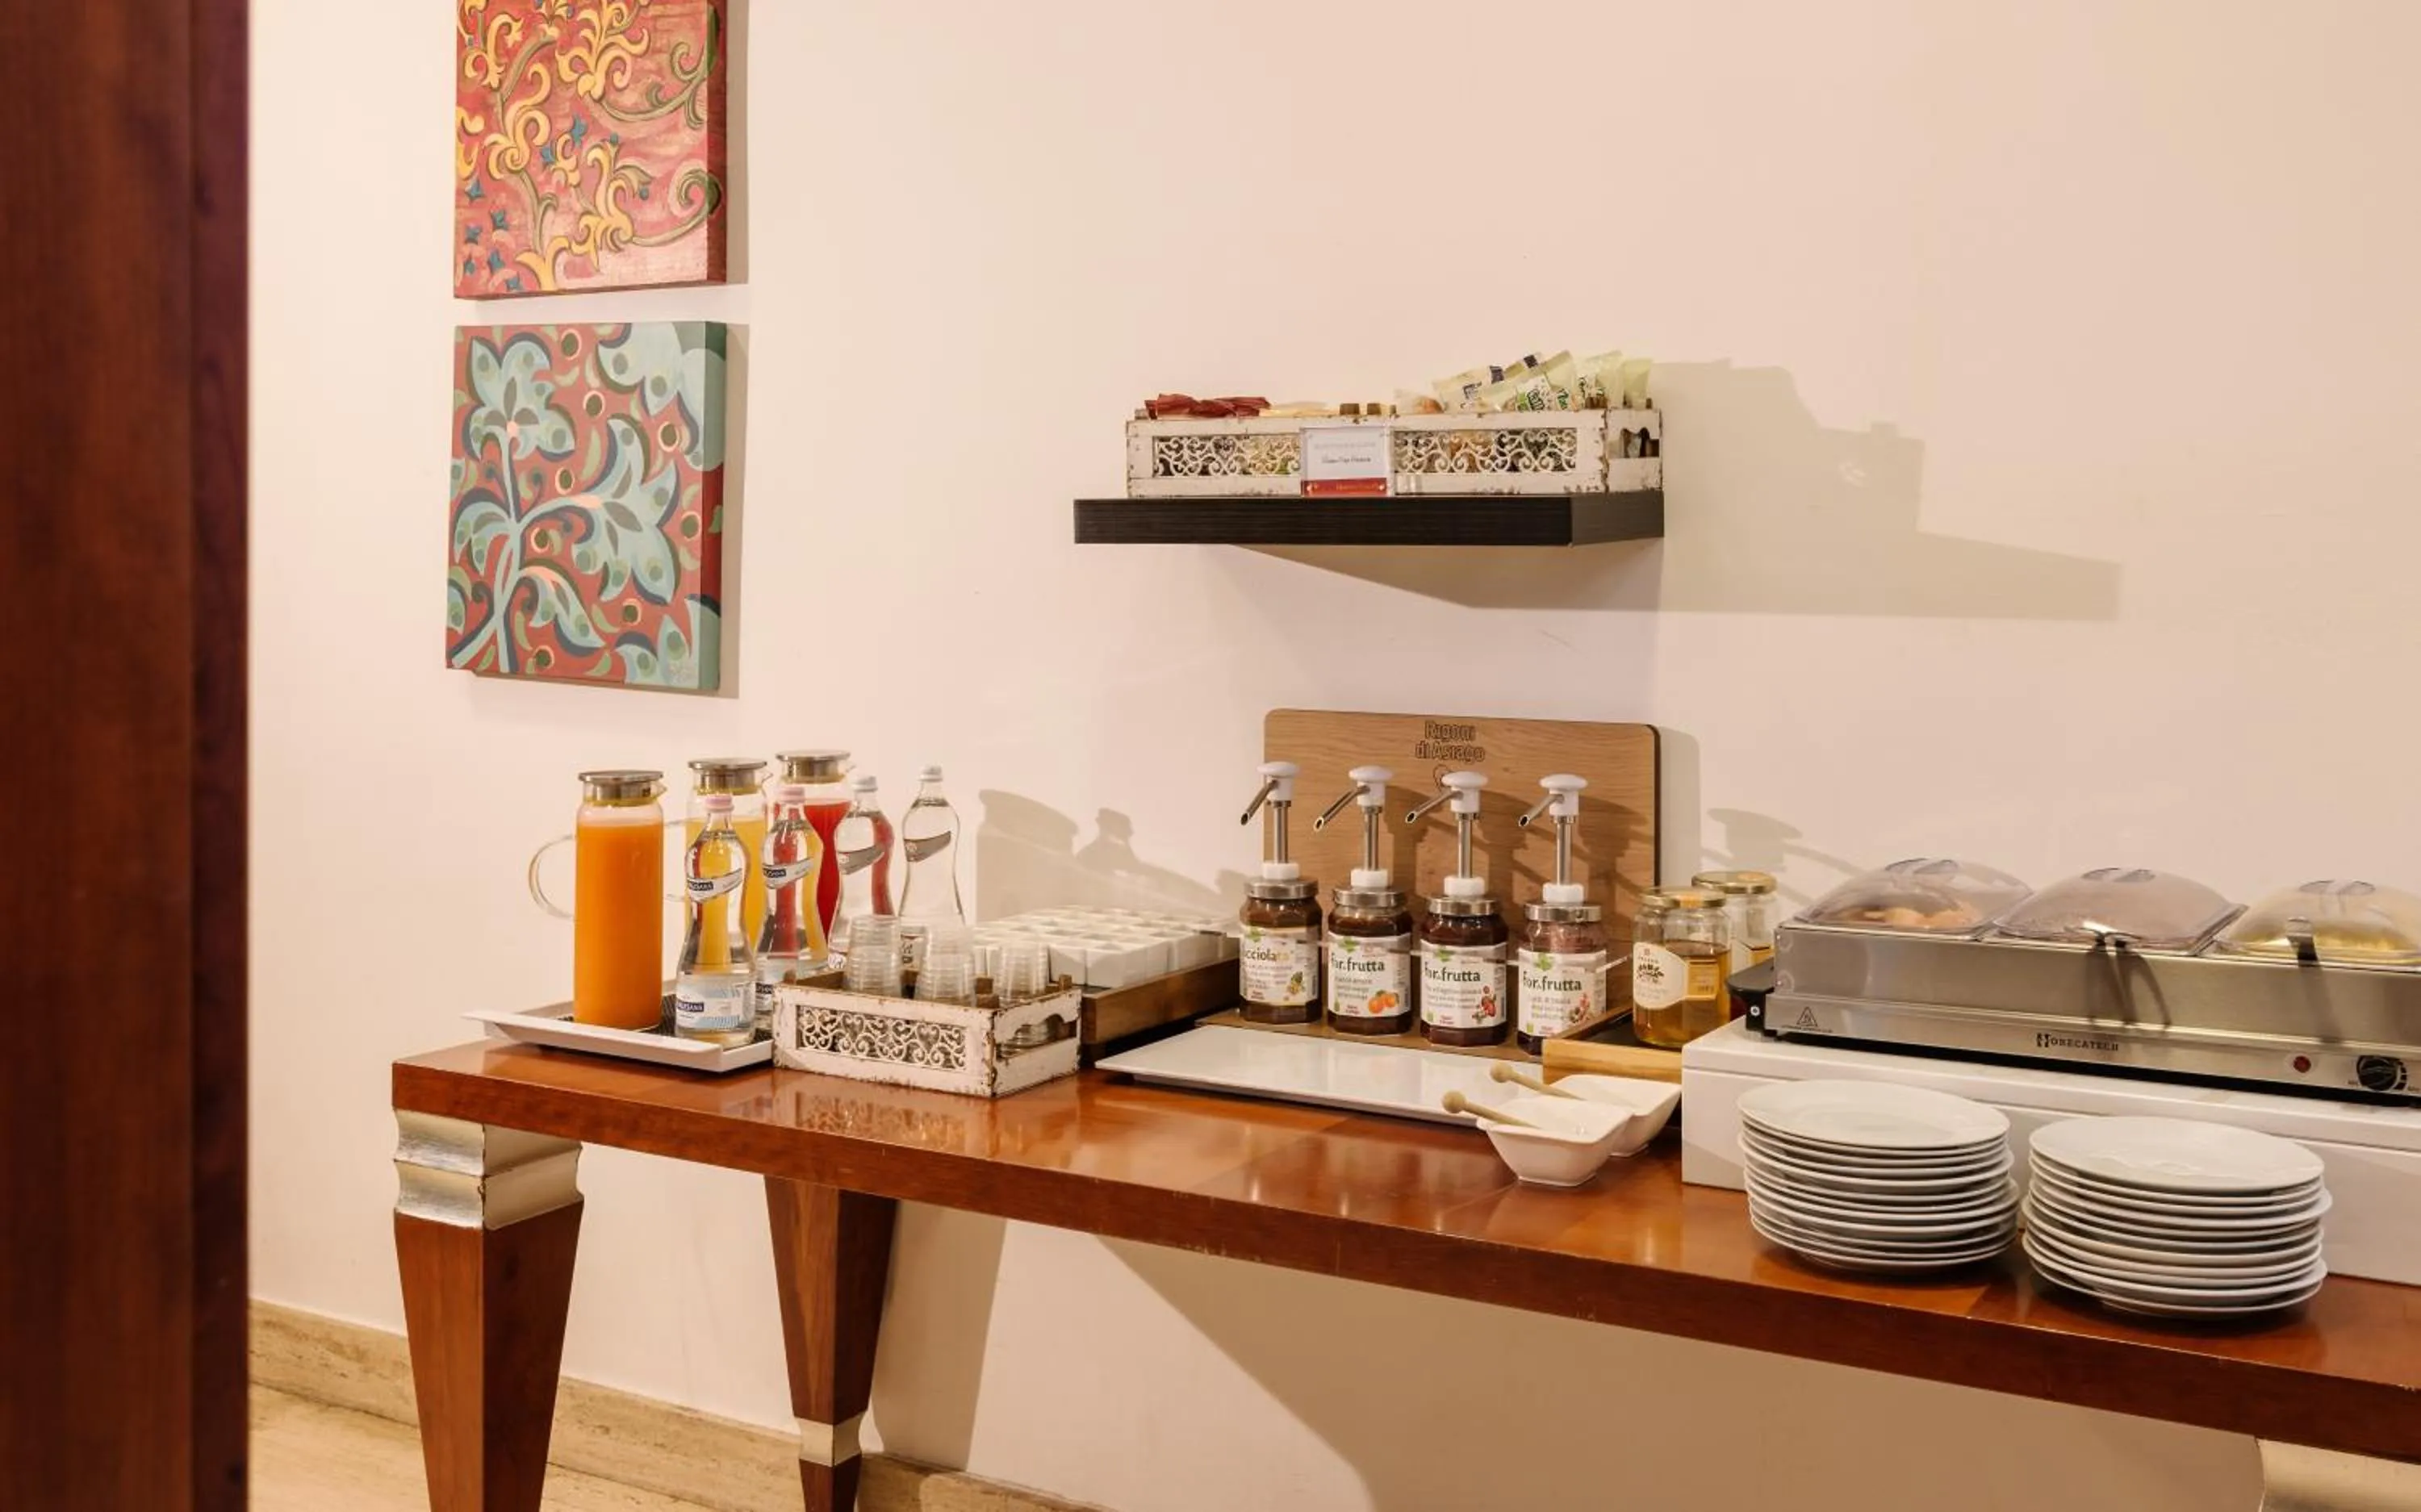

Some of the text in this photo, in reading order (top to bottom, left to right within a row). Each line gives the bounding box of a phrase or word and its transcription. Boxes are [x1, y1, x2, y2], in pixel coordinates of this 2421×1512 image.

[1424, 720, 1476, 742] Rigoni
[1415, 739, 1485, 765] di Asiago
[1541, 975, 1583, 992] frutta
[2036, 1033, 2118, 1051] HORECATECH
